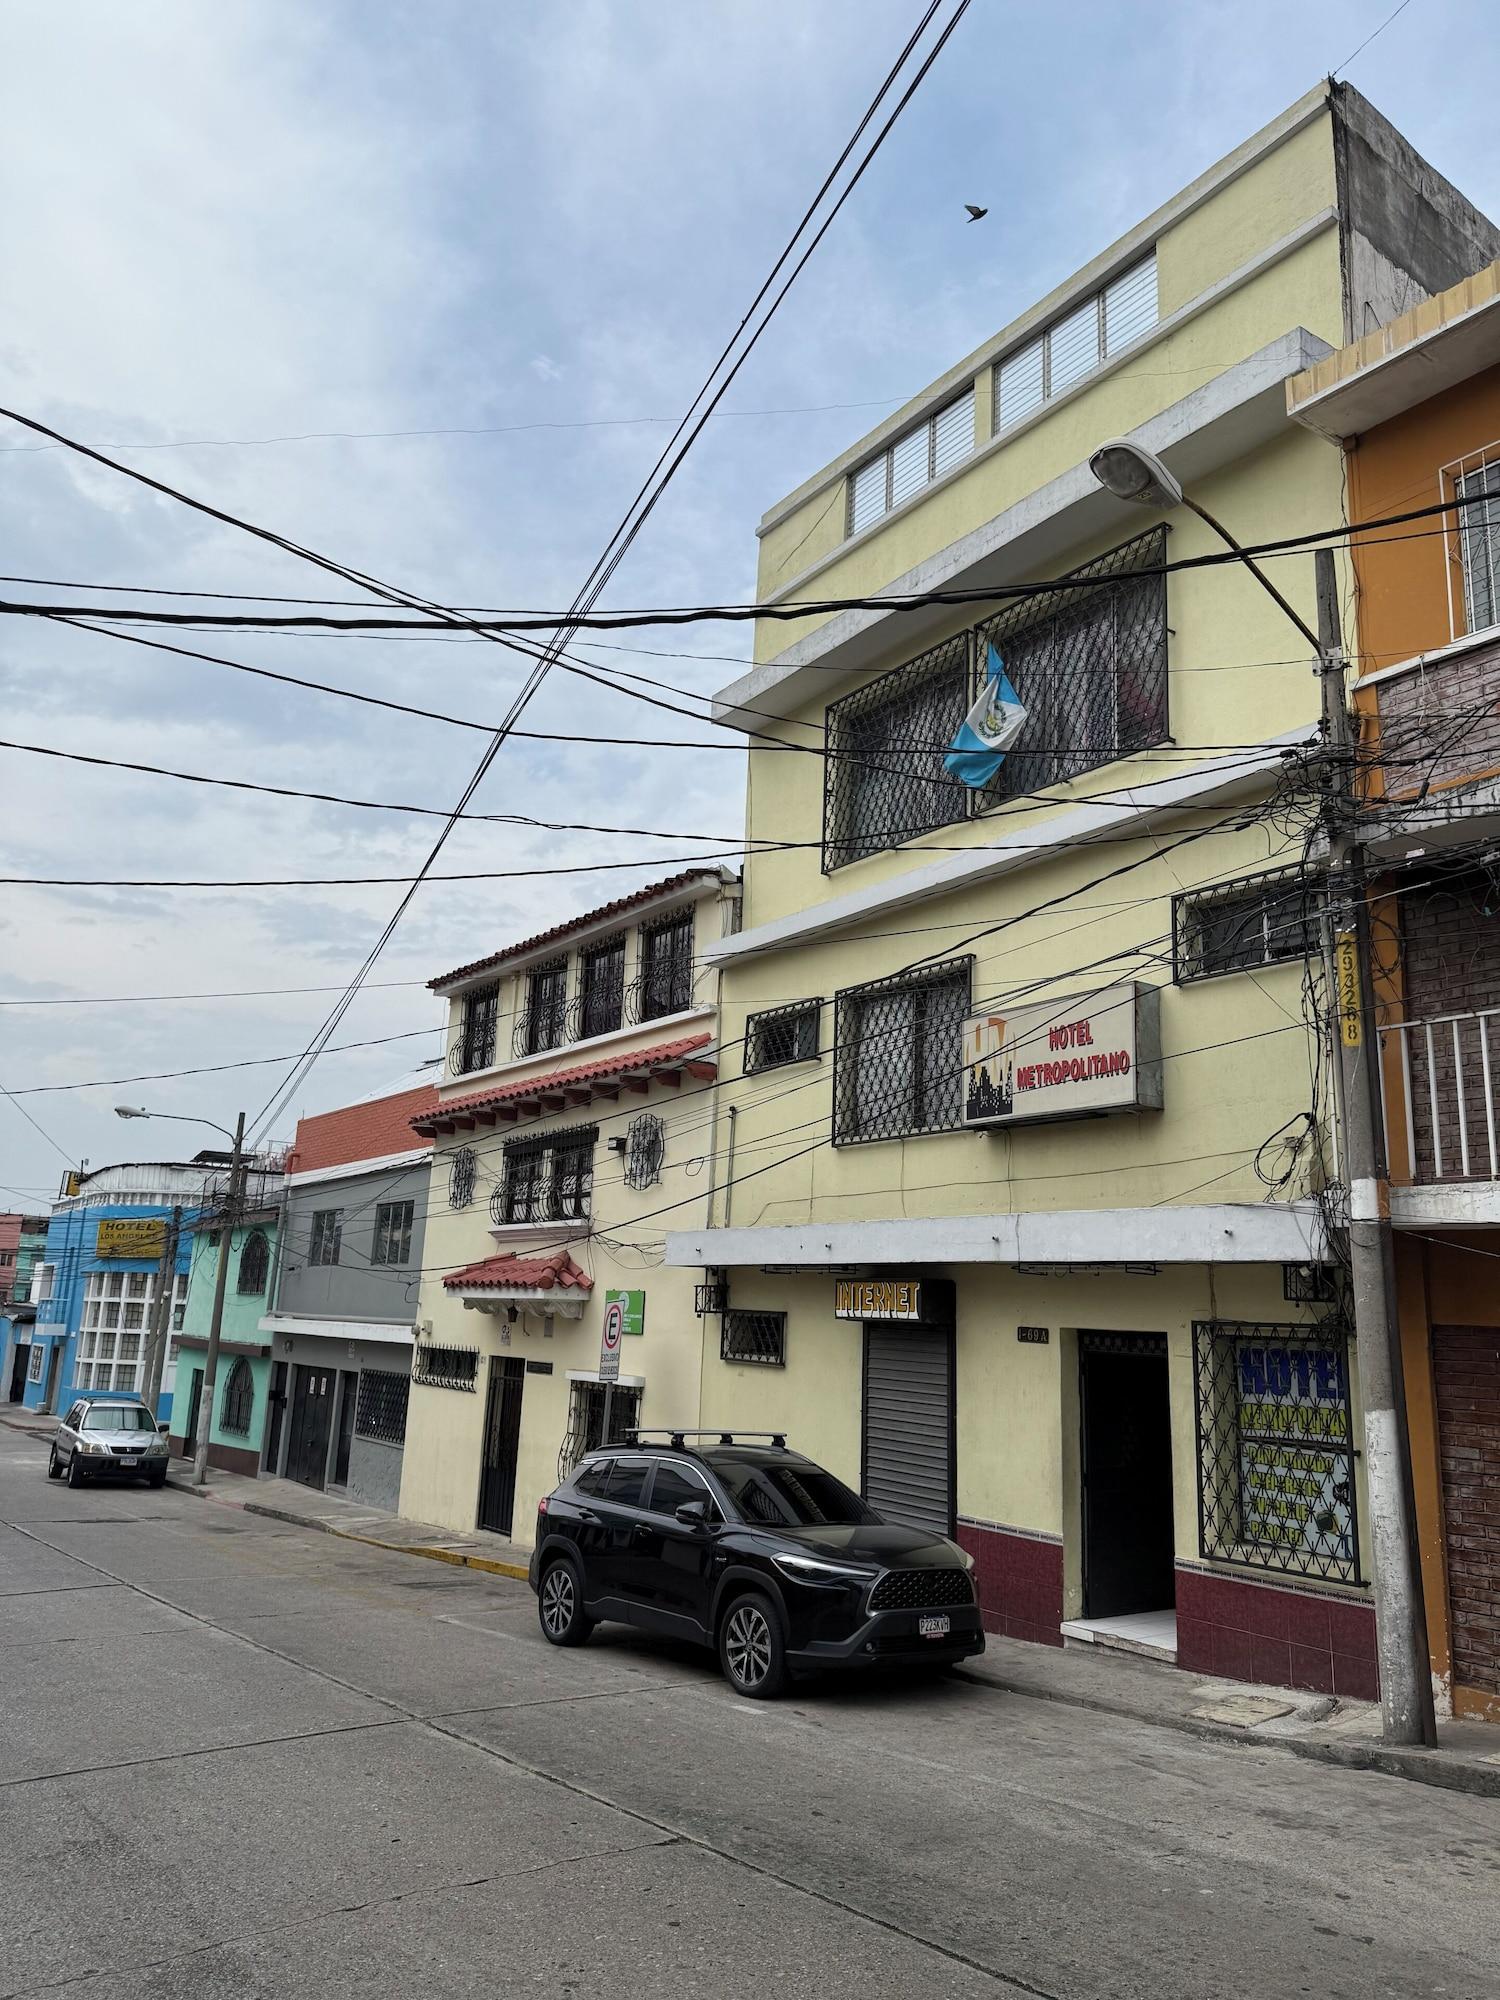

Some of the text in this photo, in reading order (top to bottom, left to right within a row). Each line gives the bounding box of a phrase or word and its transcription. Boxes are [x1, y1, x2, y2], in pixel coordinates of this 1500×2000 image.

[1049, 1020, 1093, 1051] HOTEL
[1016, 1050, 1131, 1090] METROPOLITANO
[105, 1222, 157, 1231] HOTEL
[836, 1281, 920, 1319] INTERNET
[608, 1312, 618, 1340] E
